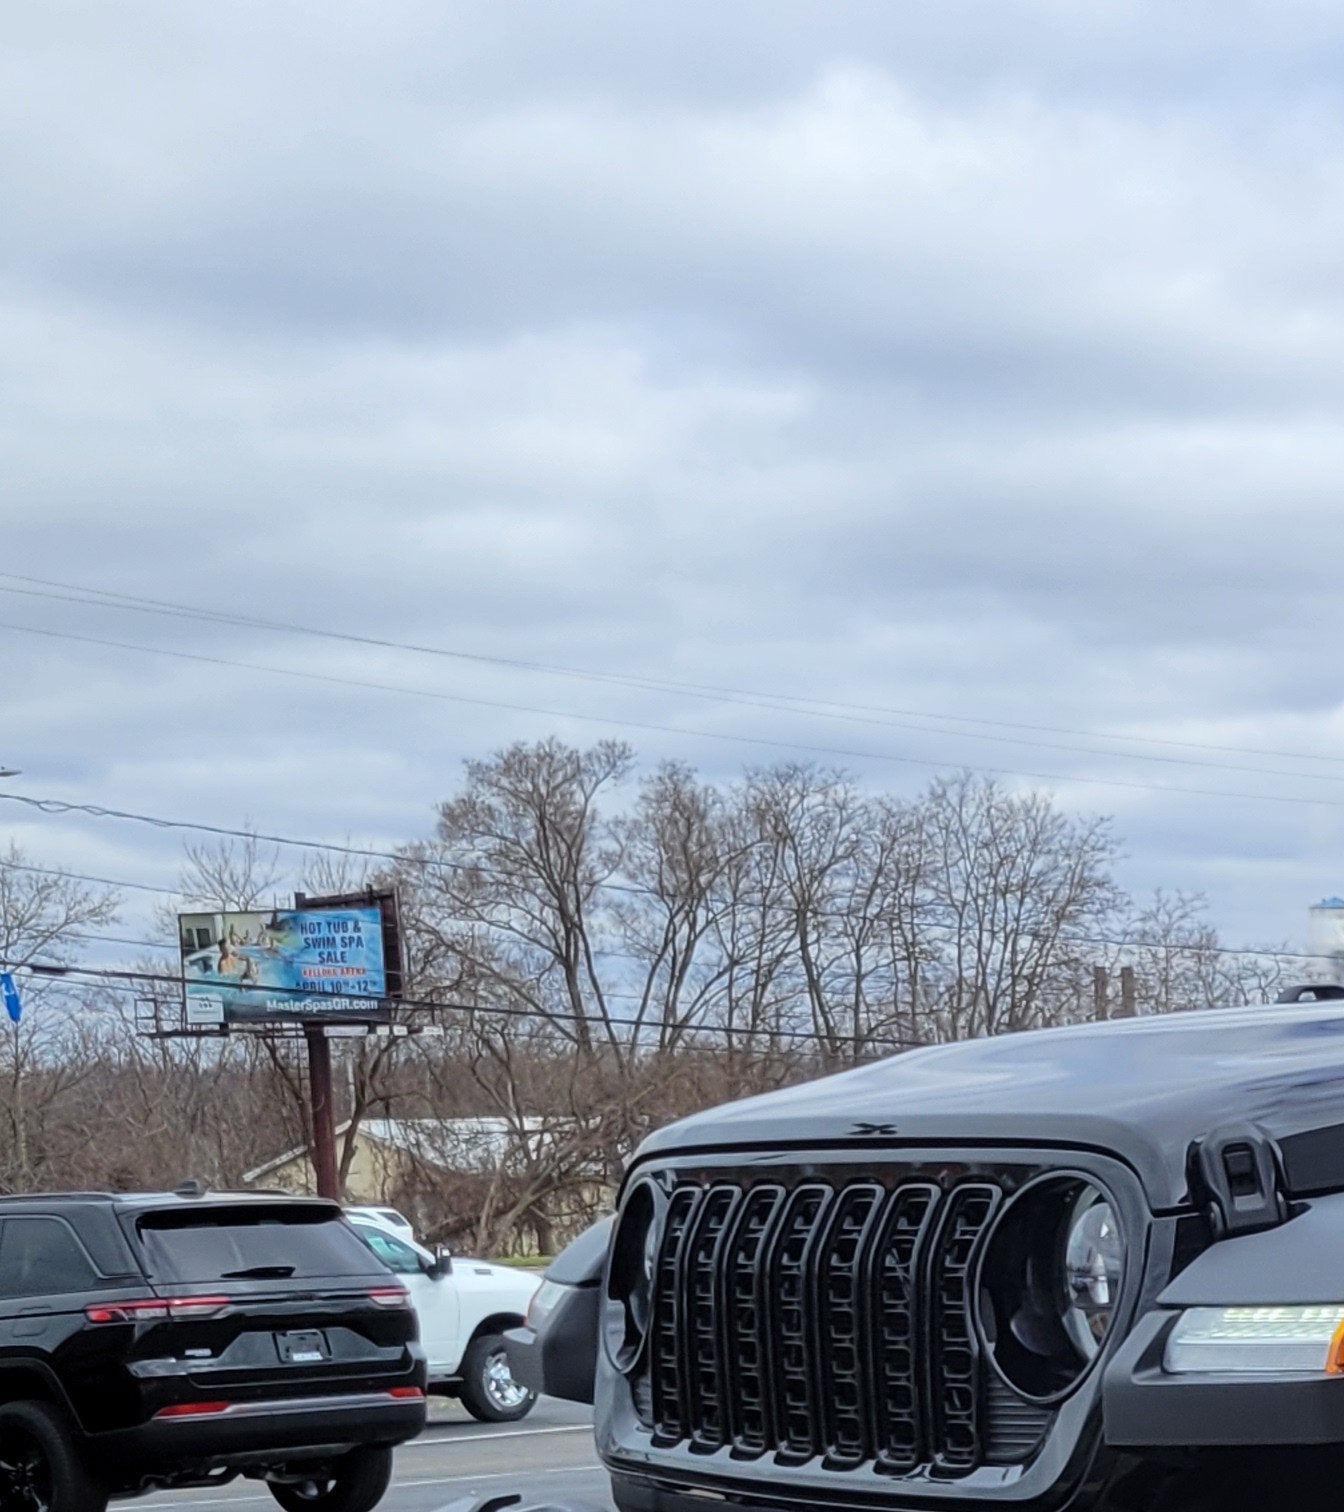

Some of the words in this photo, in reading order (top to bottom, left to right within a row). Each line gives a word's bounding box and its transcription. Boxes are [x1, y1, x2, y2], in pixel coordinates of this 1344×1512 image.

[300, 921, 322, 935] HOT
[327, 920, 349, 934] TUB
[353, 919, 362, 933] &
[303, 937, 337, 949] SWIM
[341, 936, 364, 949] SPA
[318, 951, 347, 964] SALE
